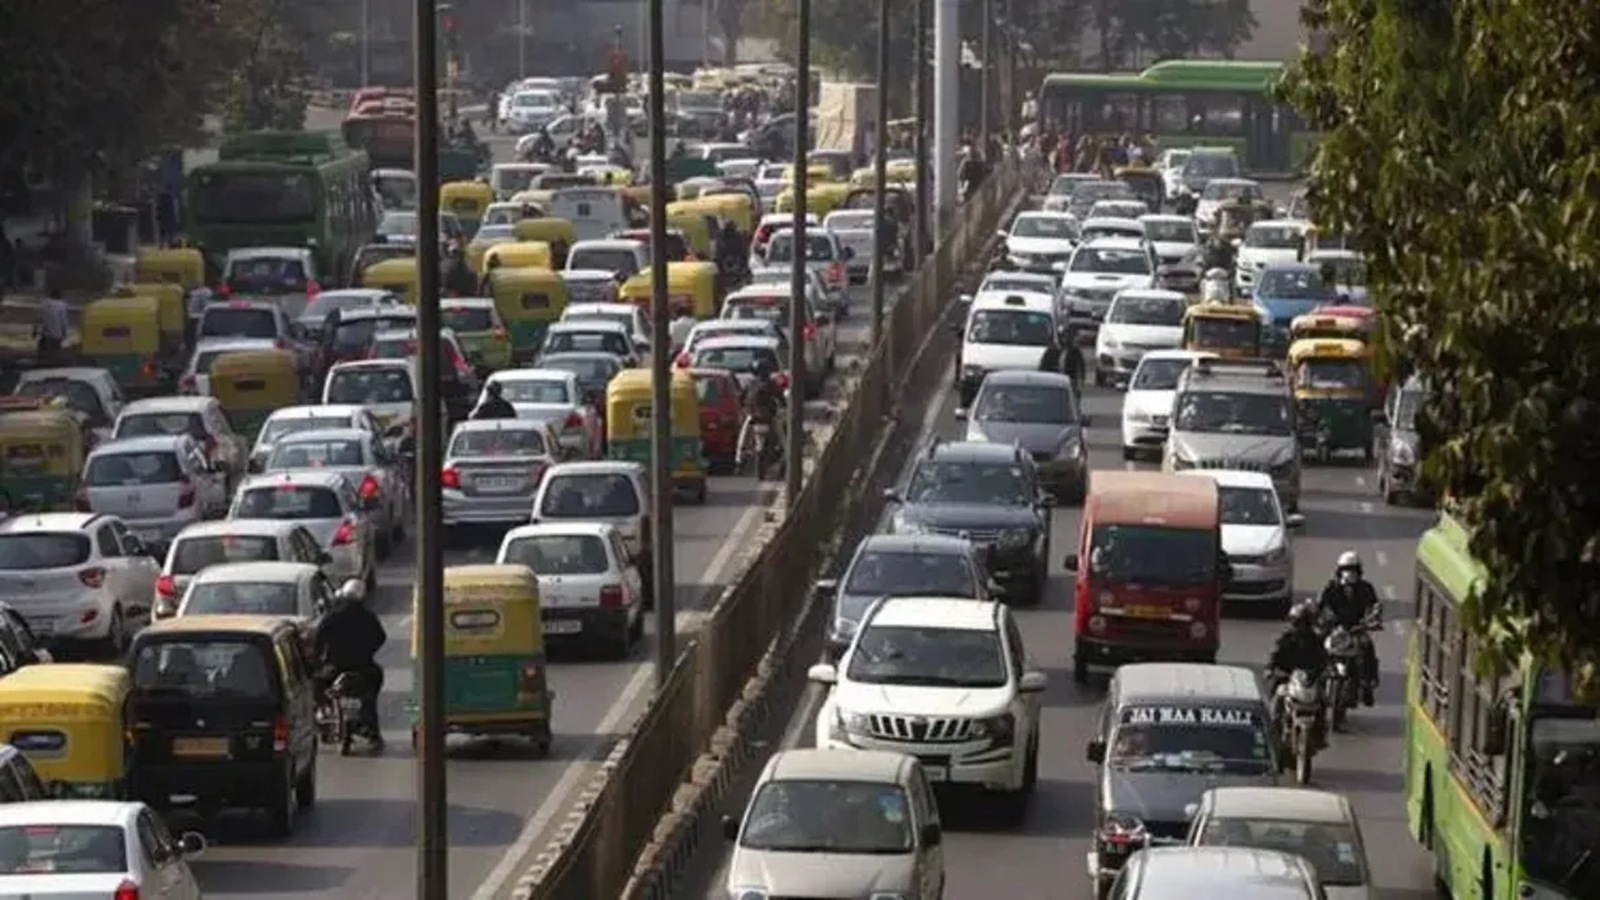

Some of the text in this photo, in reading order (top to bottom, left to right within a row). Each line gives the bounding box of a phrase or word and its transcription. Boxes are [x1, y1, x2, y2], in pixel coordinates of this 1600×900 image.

[1130, 707, 1252, 725] JAI MAA KAALI
